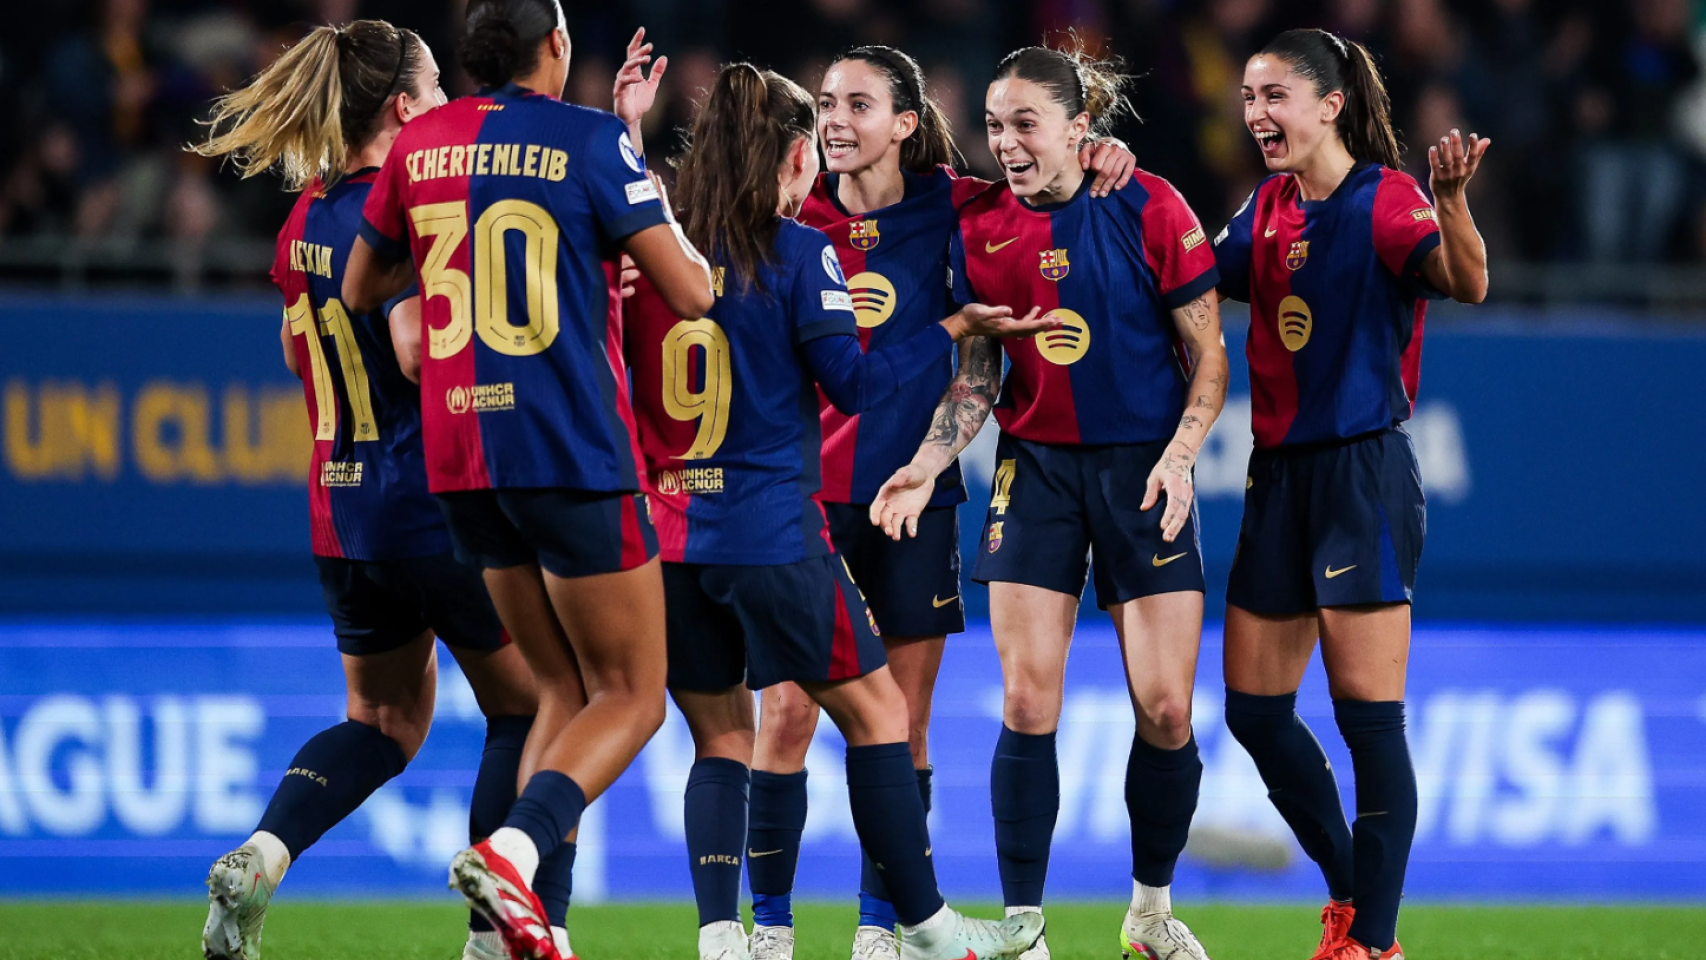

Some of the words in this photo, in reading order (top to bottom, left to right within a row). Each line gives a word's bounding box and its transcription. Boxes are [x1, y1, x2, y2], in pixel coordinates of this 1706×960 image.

[405, 144, 568, 184] SCHERTENLEIB
[290, 239, 333, 279] AEXIA
[409, 199, 560, 359] 30
[286, 292, 380, 442] 11
[471, 382, 514, 397] UNHCR
[472, 394, 515, 408] ACNUR
[661, 317, 732, 460] 9
[678, 468, 724, 480] UNHCR
[681, 480, 724, 491] ACNUR
[990, 459, 1016, 515] 4
